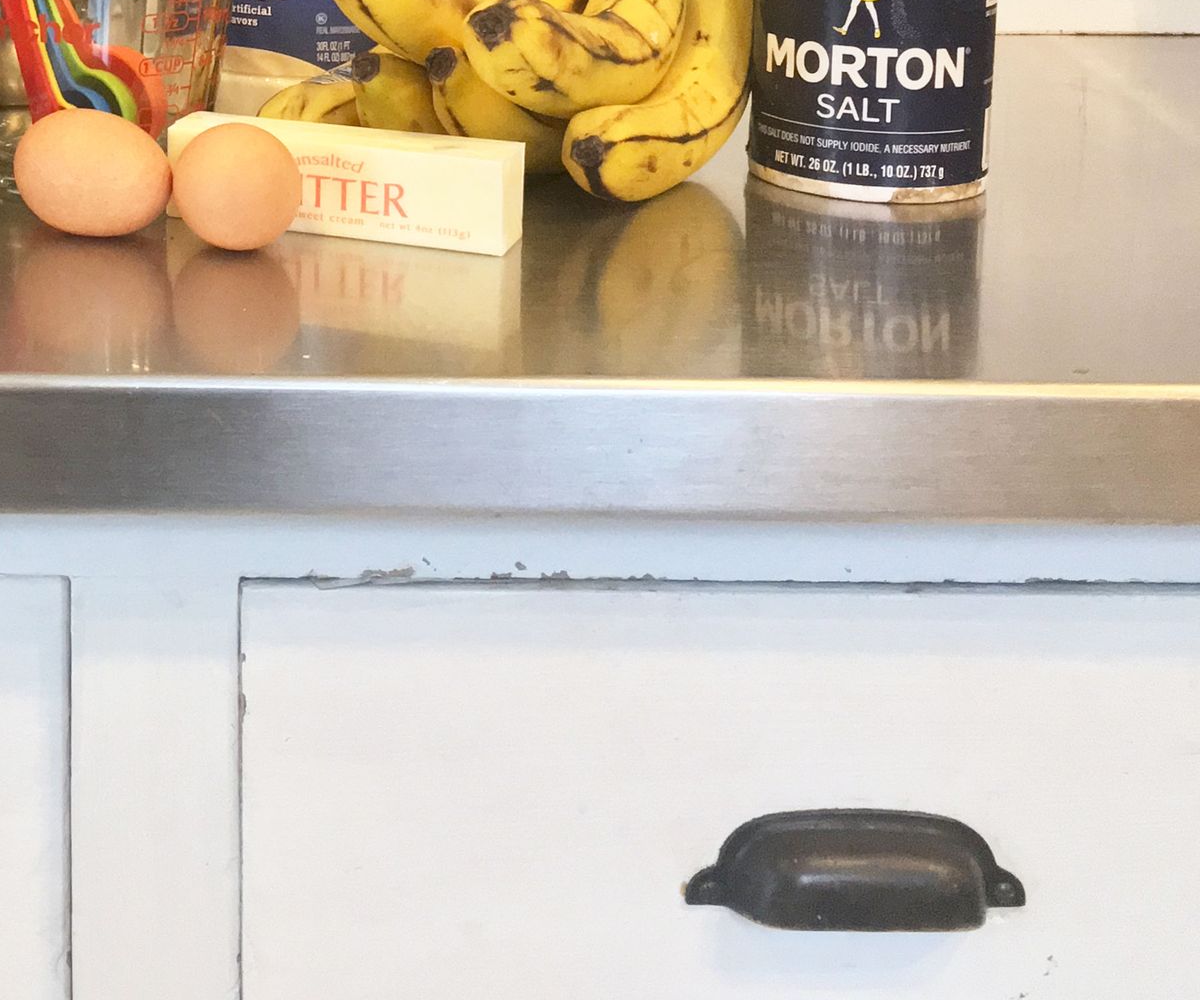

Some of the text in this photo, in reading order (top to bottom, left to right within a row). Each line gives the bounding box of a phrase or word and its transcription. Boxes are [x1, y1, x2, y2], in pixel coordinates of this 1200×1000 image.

[232, 4, 272, 16] rtificial
[231, 16, 258, 27] avors
[155, 59, 181, 72] CUP
[765, 32, 965, 91] MORTON
[816, 93, 900, 123] SALT
[767, 126, 781, 140] SALT
[781, 131, 799, 144] DOES
[799, 134, 816, 146] NOT
[816, 137, 848, 150] SUPPLY
[850, 142, 882, 155] IODIDE,
[883, 144, 890, 154] A
[892, 143, 939, 154] NECESSARY
[774, 150, 944, 180] NET WT. 26 OZ. (1 LB., 10 OZ.) 737 g
[298, 213, 364, 226] weet cream
[379, 221, 395, 230] net
[400, 222, 411, 231] wt
